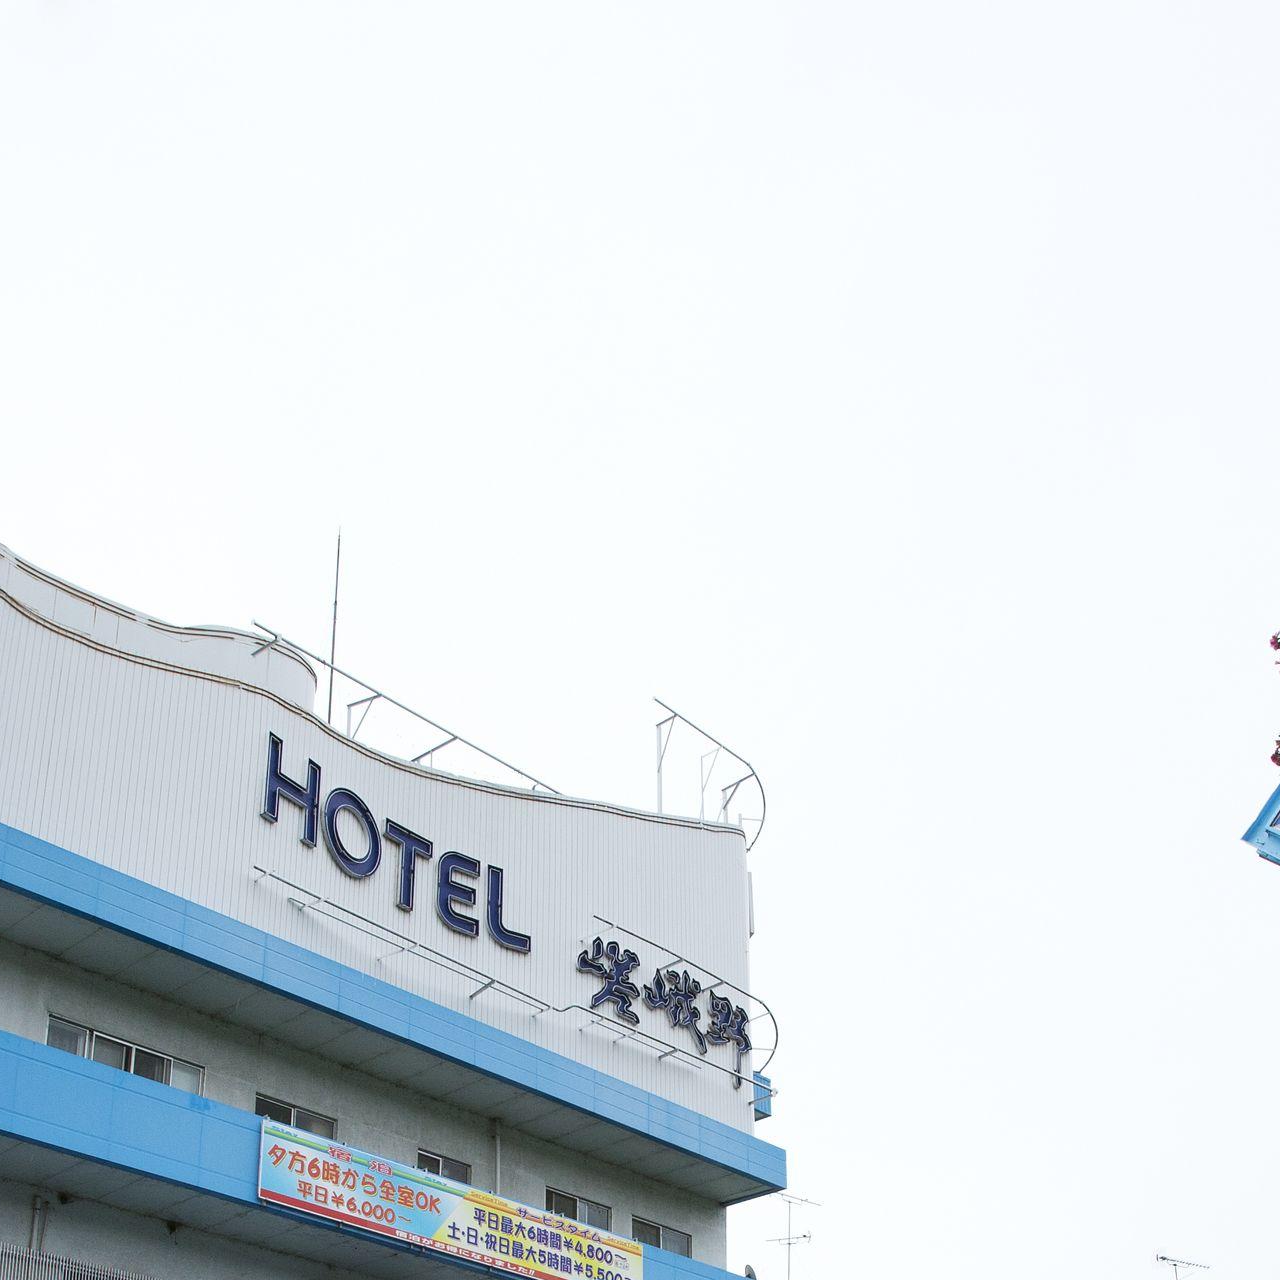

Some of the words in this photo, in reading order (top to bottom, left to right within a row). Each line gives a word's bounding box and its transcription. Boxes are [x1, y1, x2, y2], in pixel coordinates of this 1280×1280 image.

[260, 731, 531, 954] HOTEL
[267, 1144, 442, 1215] 夕方6時から全室OK
[517, 1207, 601, 1243] サービスタイム
